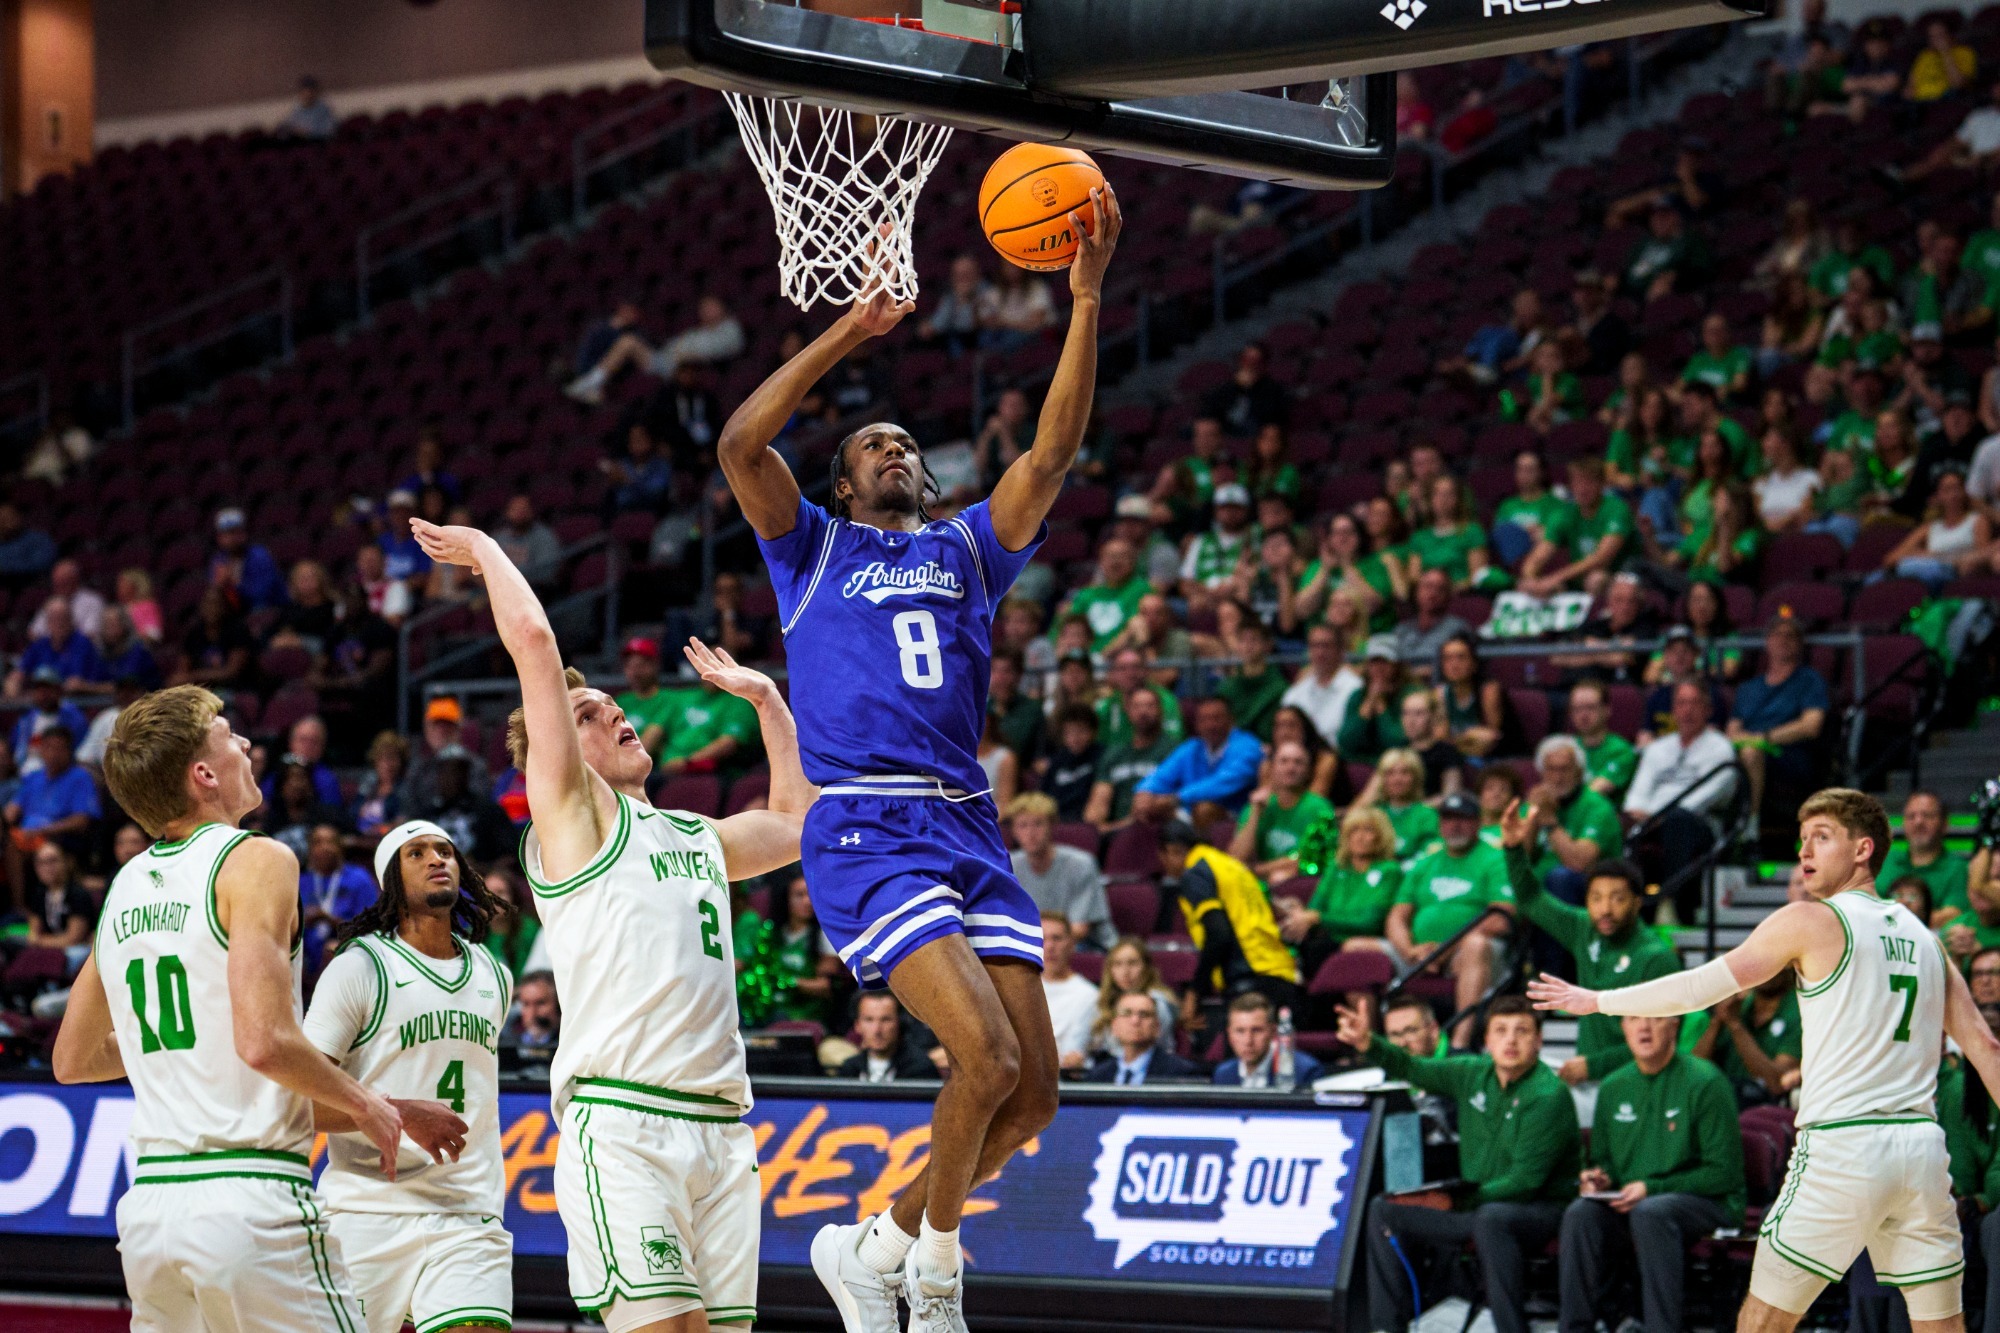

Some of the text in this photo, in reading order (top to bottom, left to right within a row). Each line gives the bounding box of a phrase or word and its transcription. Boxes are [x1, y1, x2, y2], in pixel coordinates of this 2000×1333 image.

[843, 561, 964, 598] Arlington
[893, 610, 943, 688] 8
[698, 898, 724, 961] 2
[1879, 936, 1917, 964] TAITZ
[125, 954, 196, 1054] 10
[1889, 974, 1918, 1042] 7
[400, 1009, 497, 1055] WOLVERINES
[436, 1060, 465, 1114] 4
[1120, 1151, 1322, 1207] SOLD OUT
[1149, 1244, 1315, 1268] SOLDOUT.COM
